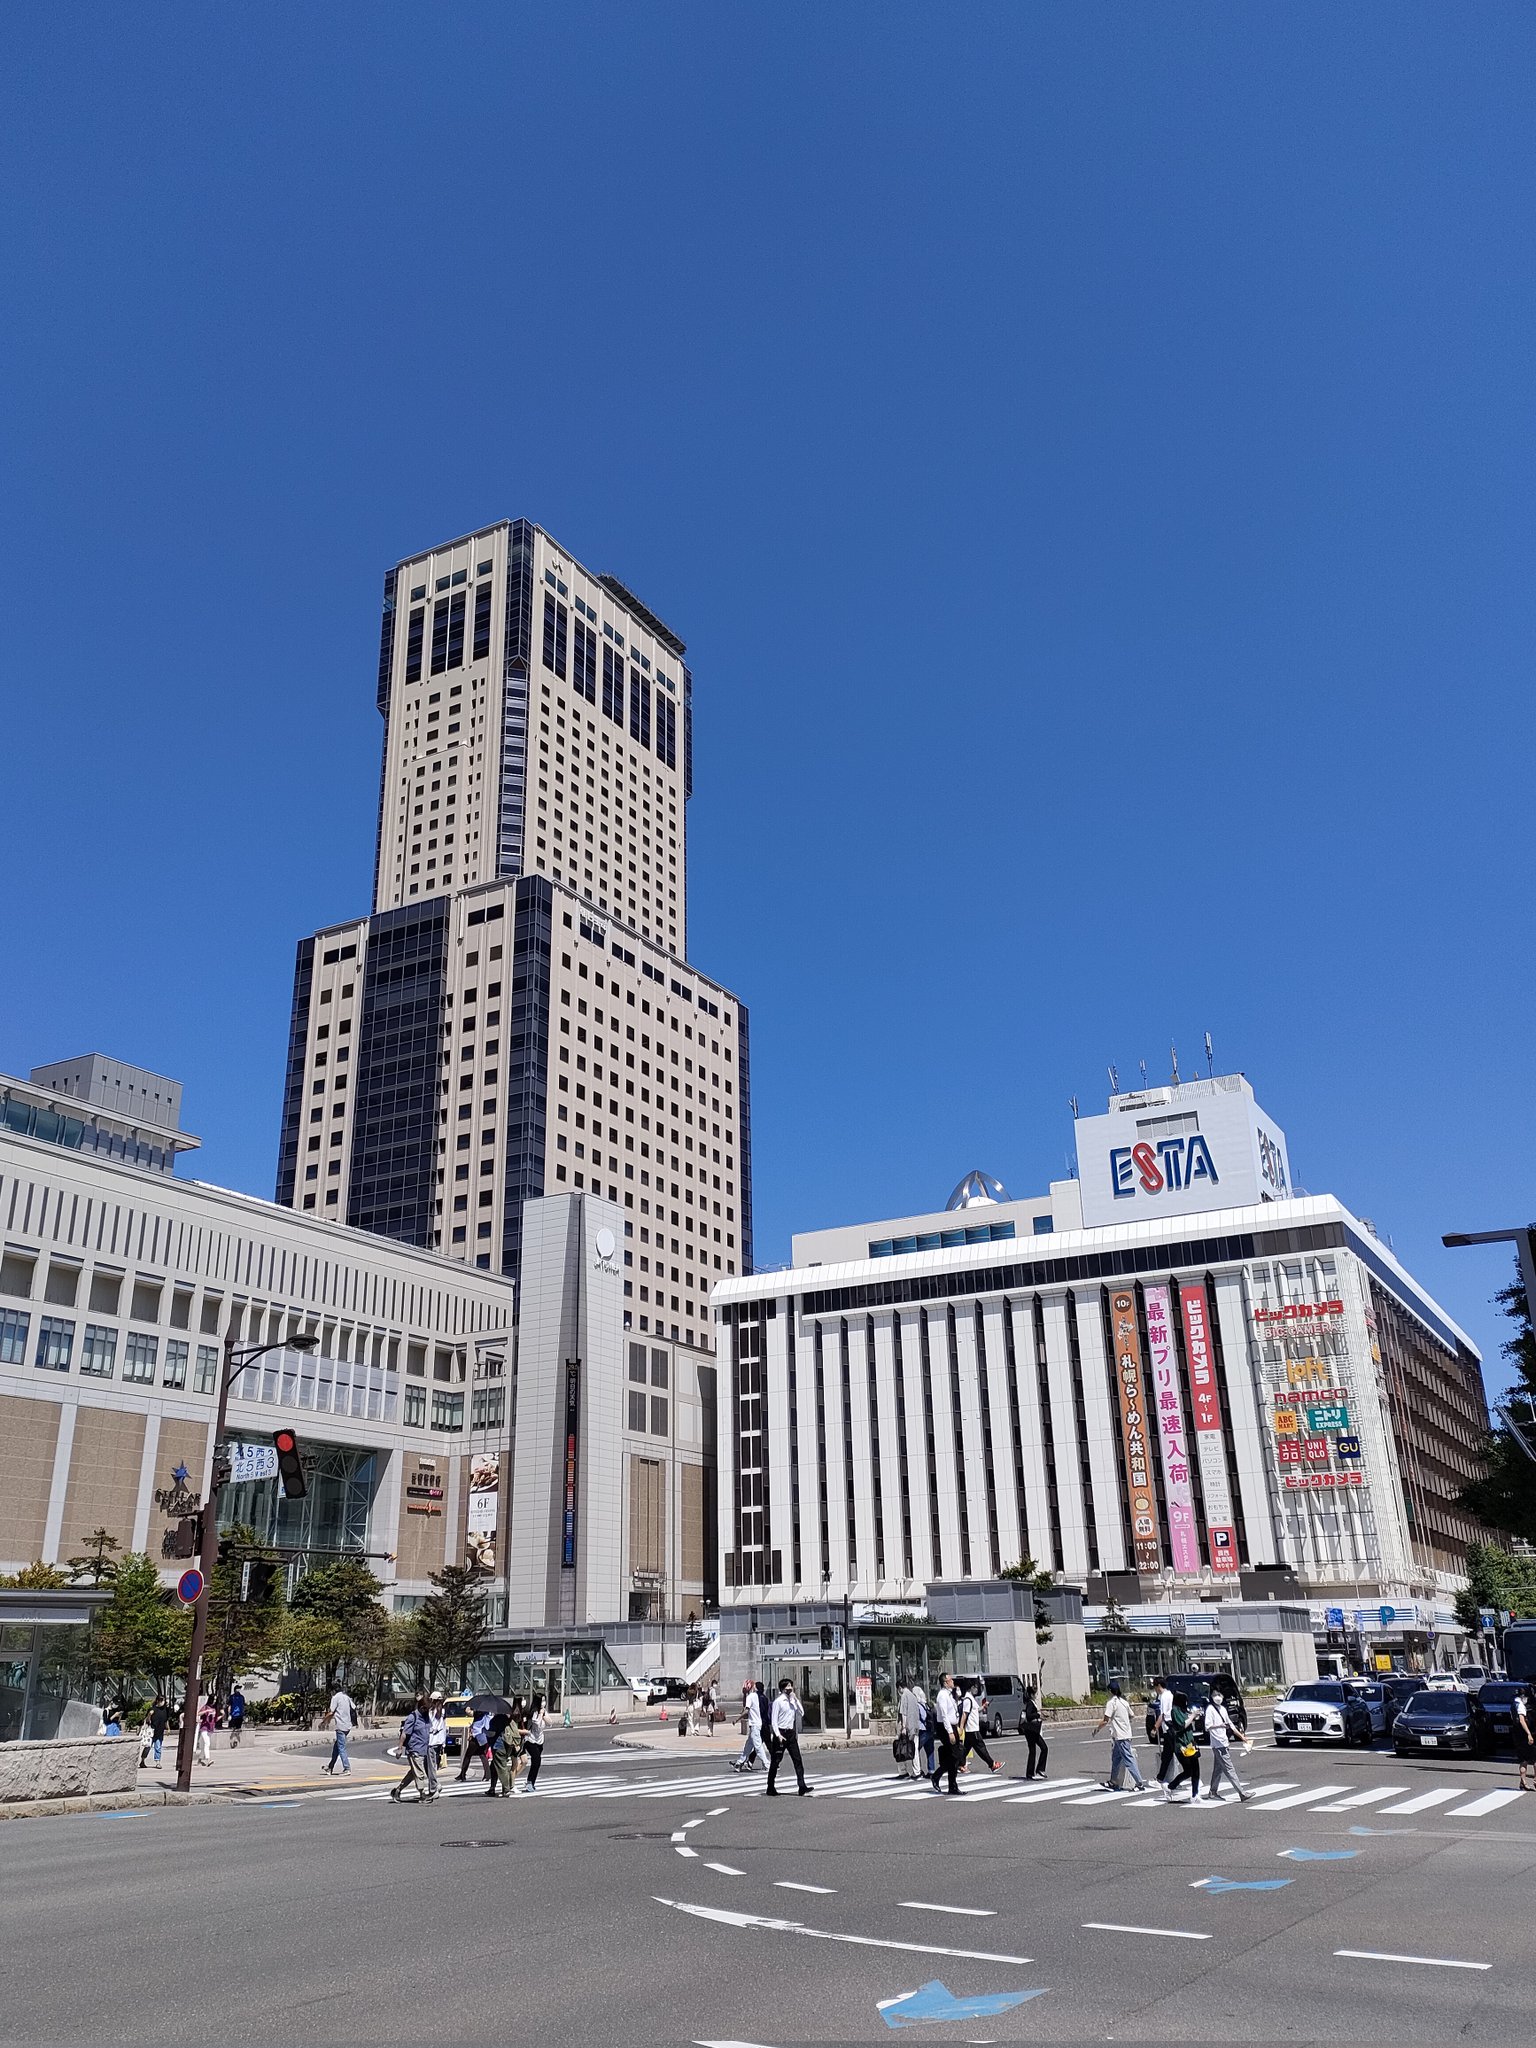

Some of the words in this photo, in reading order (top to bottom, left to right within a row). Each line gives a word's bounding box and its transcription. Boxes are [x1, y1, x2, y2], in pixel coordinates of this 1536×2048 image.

[1110, 1135, 1219, 1198] ESTA
[1257, 1126, 1288, 1196] ESTA
[1116, 1299, 1130, 1308] 10F
[1254, 1300, 1344, 1322] ビックカメラ
[1288, 1321, 1340, 1336] CAMERA
[1186, 1299, 1210, 1385] ビックカメラ
[1147, 1302, 1188, 1485] 最新プリ最速入荷
[1198, 1394, 1212, 1403] 4F
[1274, 1388, 1348, 1404] namco
[1201, 1413, 1213, 1423] 1F
[1277, 1414, 1293, 1424] ABC
[1314, 1410, 1341, 1422] ニトリ
[1315, 1420, 1343, 1429] EXPRESS
[1306, 1441, 1322, 1450] UNI
[1338, 1442, 1358, 1453] GU
[1308, 1449, 1325, 1459] QLO
[236, 1457, 275, 1473] 北5西3
[1285, 1472, 1363, 1488] ビックカメラ
[155, 1488, 202, 1505] STELLAR
[477, 1497, 490, 1509] 6F
[1173, 1511, 1190, 1523] 9F
[1215, 1532, 1228, 1546] P
[1136, 1541, 1157, 1551] 11:00
[1138, 1561, 1159, 1570] 22:00
[1380, 1606, 1396, 1625] P
[783, 1646, 800, 1655] APIA
